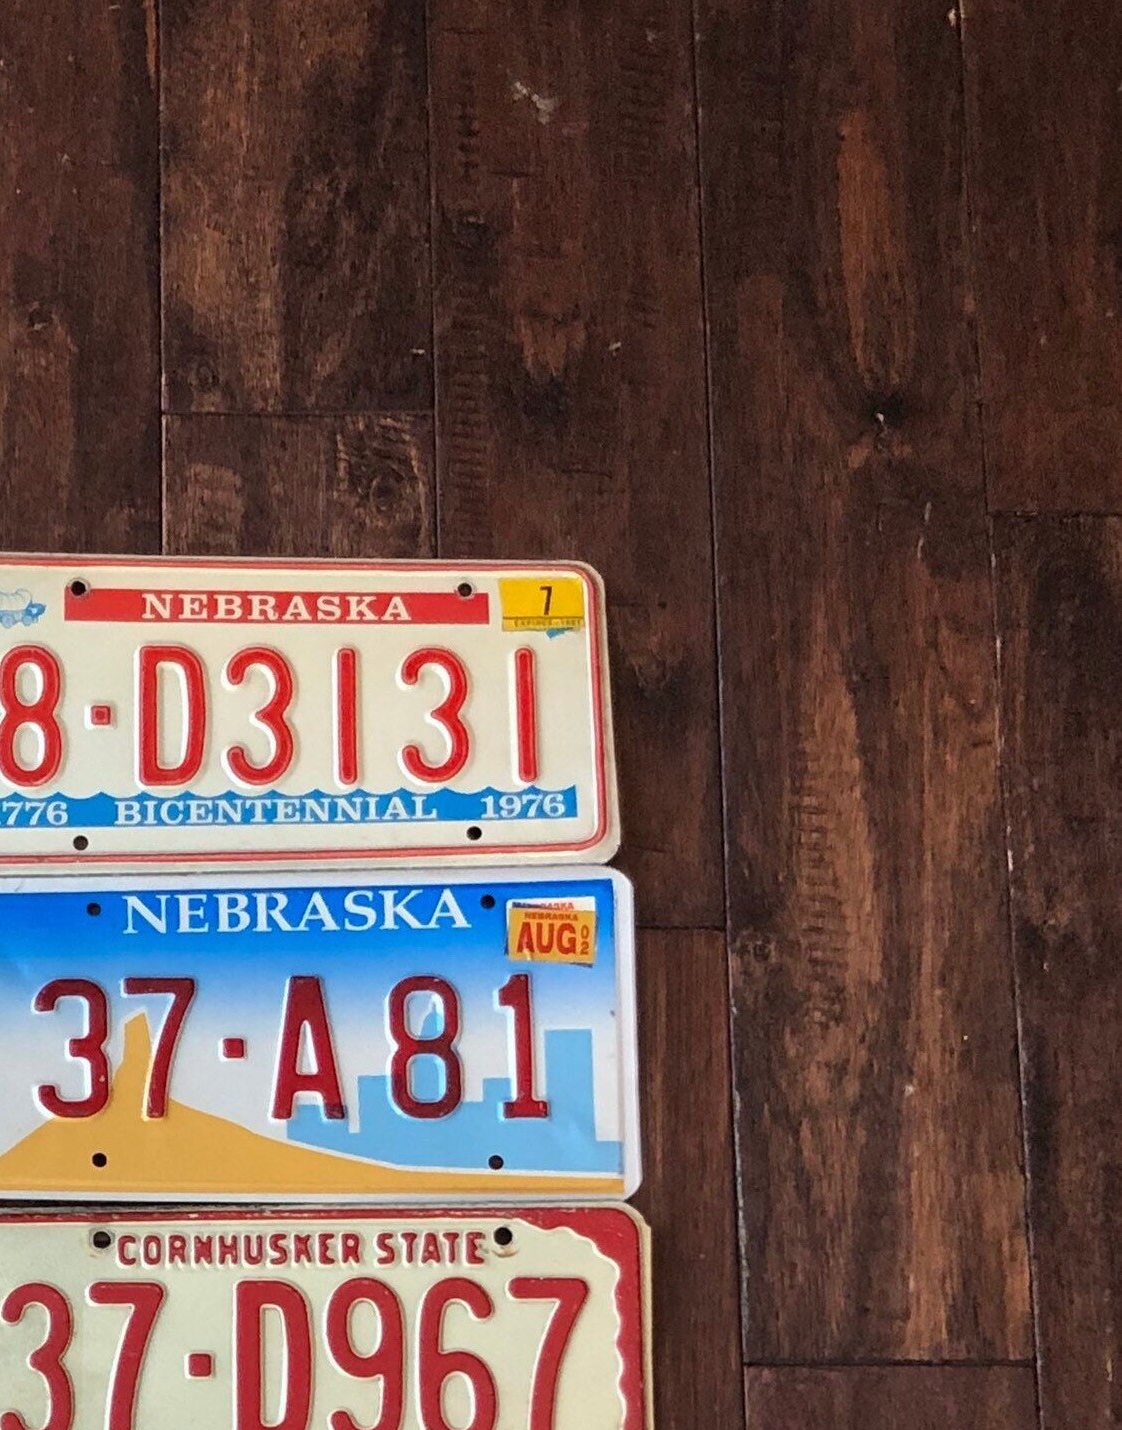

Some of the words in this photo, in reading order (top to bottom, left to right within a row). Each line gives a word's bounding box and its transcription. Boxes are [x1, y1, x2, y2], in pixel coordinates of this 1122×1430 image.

[141, 594, 412, 622] NEBRASKA
[540, 586, 552, 615] 7
[114, 797, 437, 825] BICENTENNIAL
[480, 793, 565, 818] 1976
[122, 889, 471, 935] NEBRASKA
[516, 922, 576, 955] AUG
[116, 1232, 361, 1266] CORNHUSKER
[377, 1232, 486, 1265] STATE
